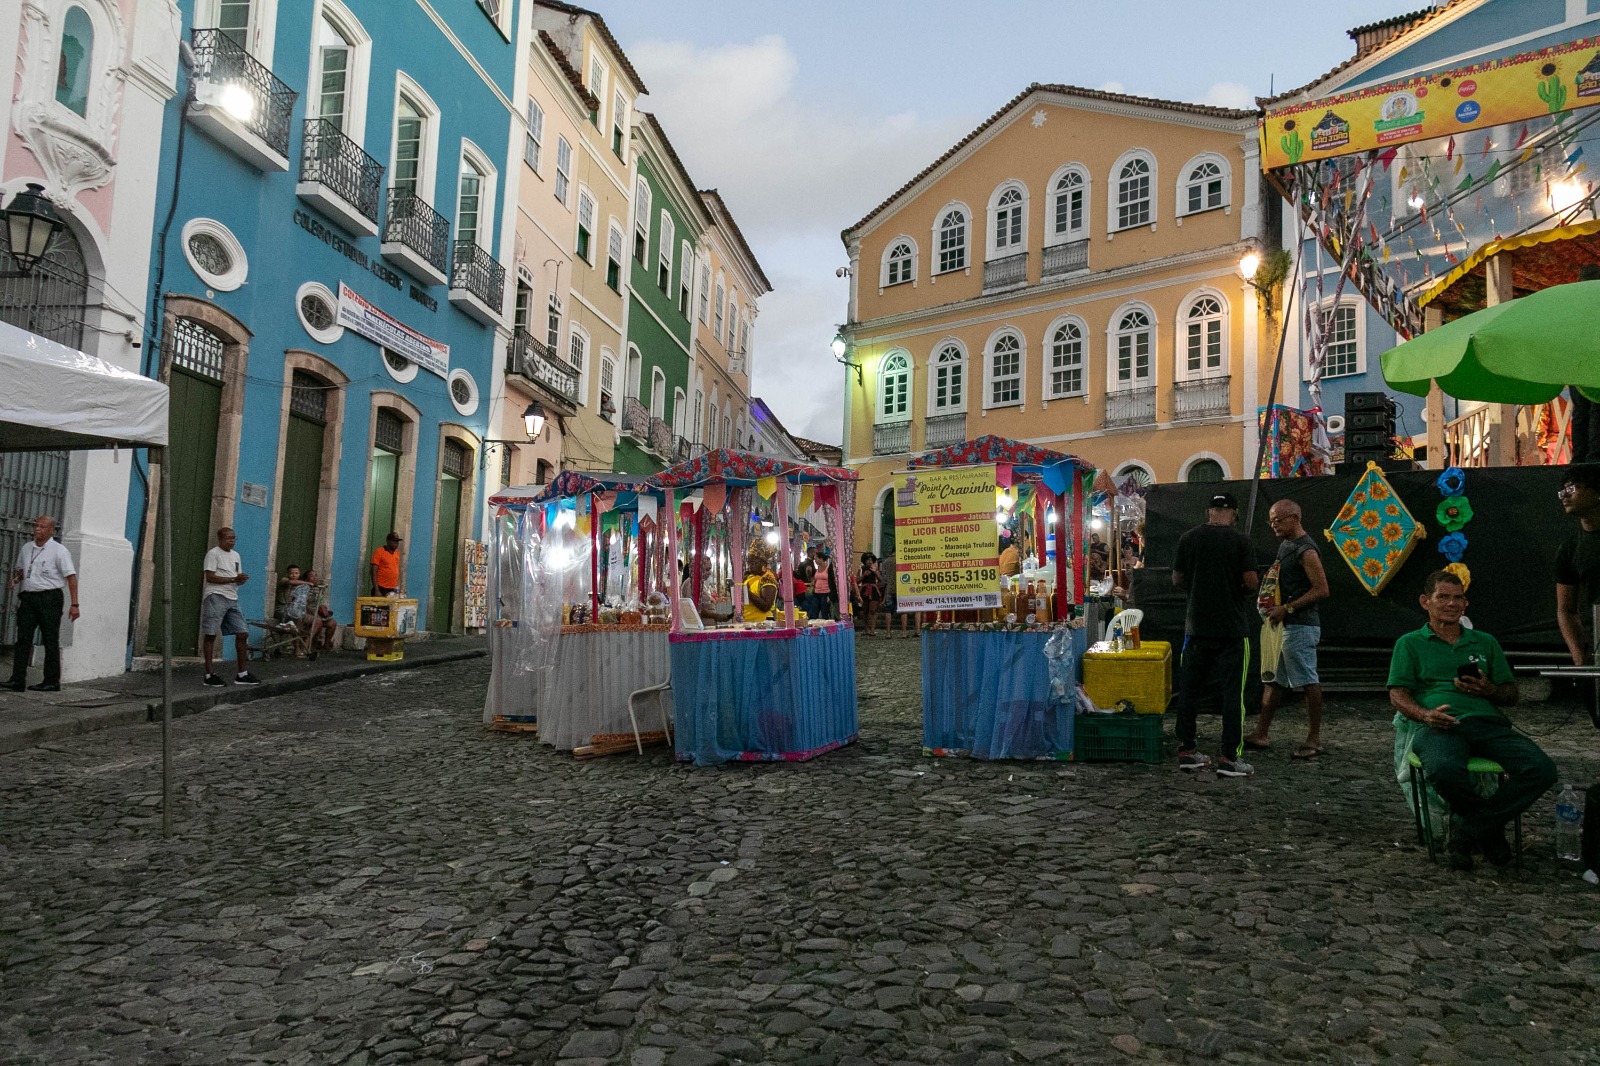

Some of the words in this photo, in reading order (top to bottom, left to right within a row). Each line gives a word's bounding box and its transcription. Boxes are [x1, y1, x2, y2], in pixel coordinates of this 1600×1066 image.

[949, 472, 989, 481] RESTAURANTE
[920, 483, 941, 493] Point
[940, 482, 995, 499] Cravinho
[929, 503, 962, 513] TEMOS
[913, 527, 937, 536] LICOR
[940, 524, 980, 534] CREMOSO
[903, 546, 935, 554] Cappuccino
[911, 561, 950, 570] CHURRASCO
[963, 559, 984, 567] PRATO
[922, 569, 996, 584] 99655-3198
